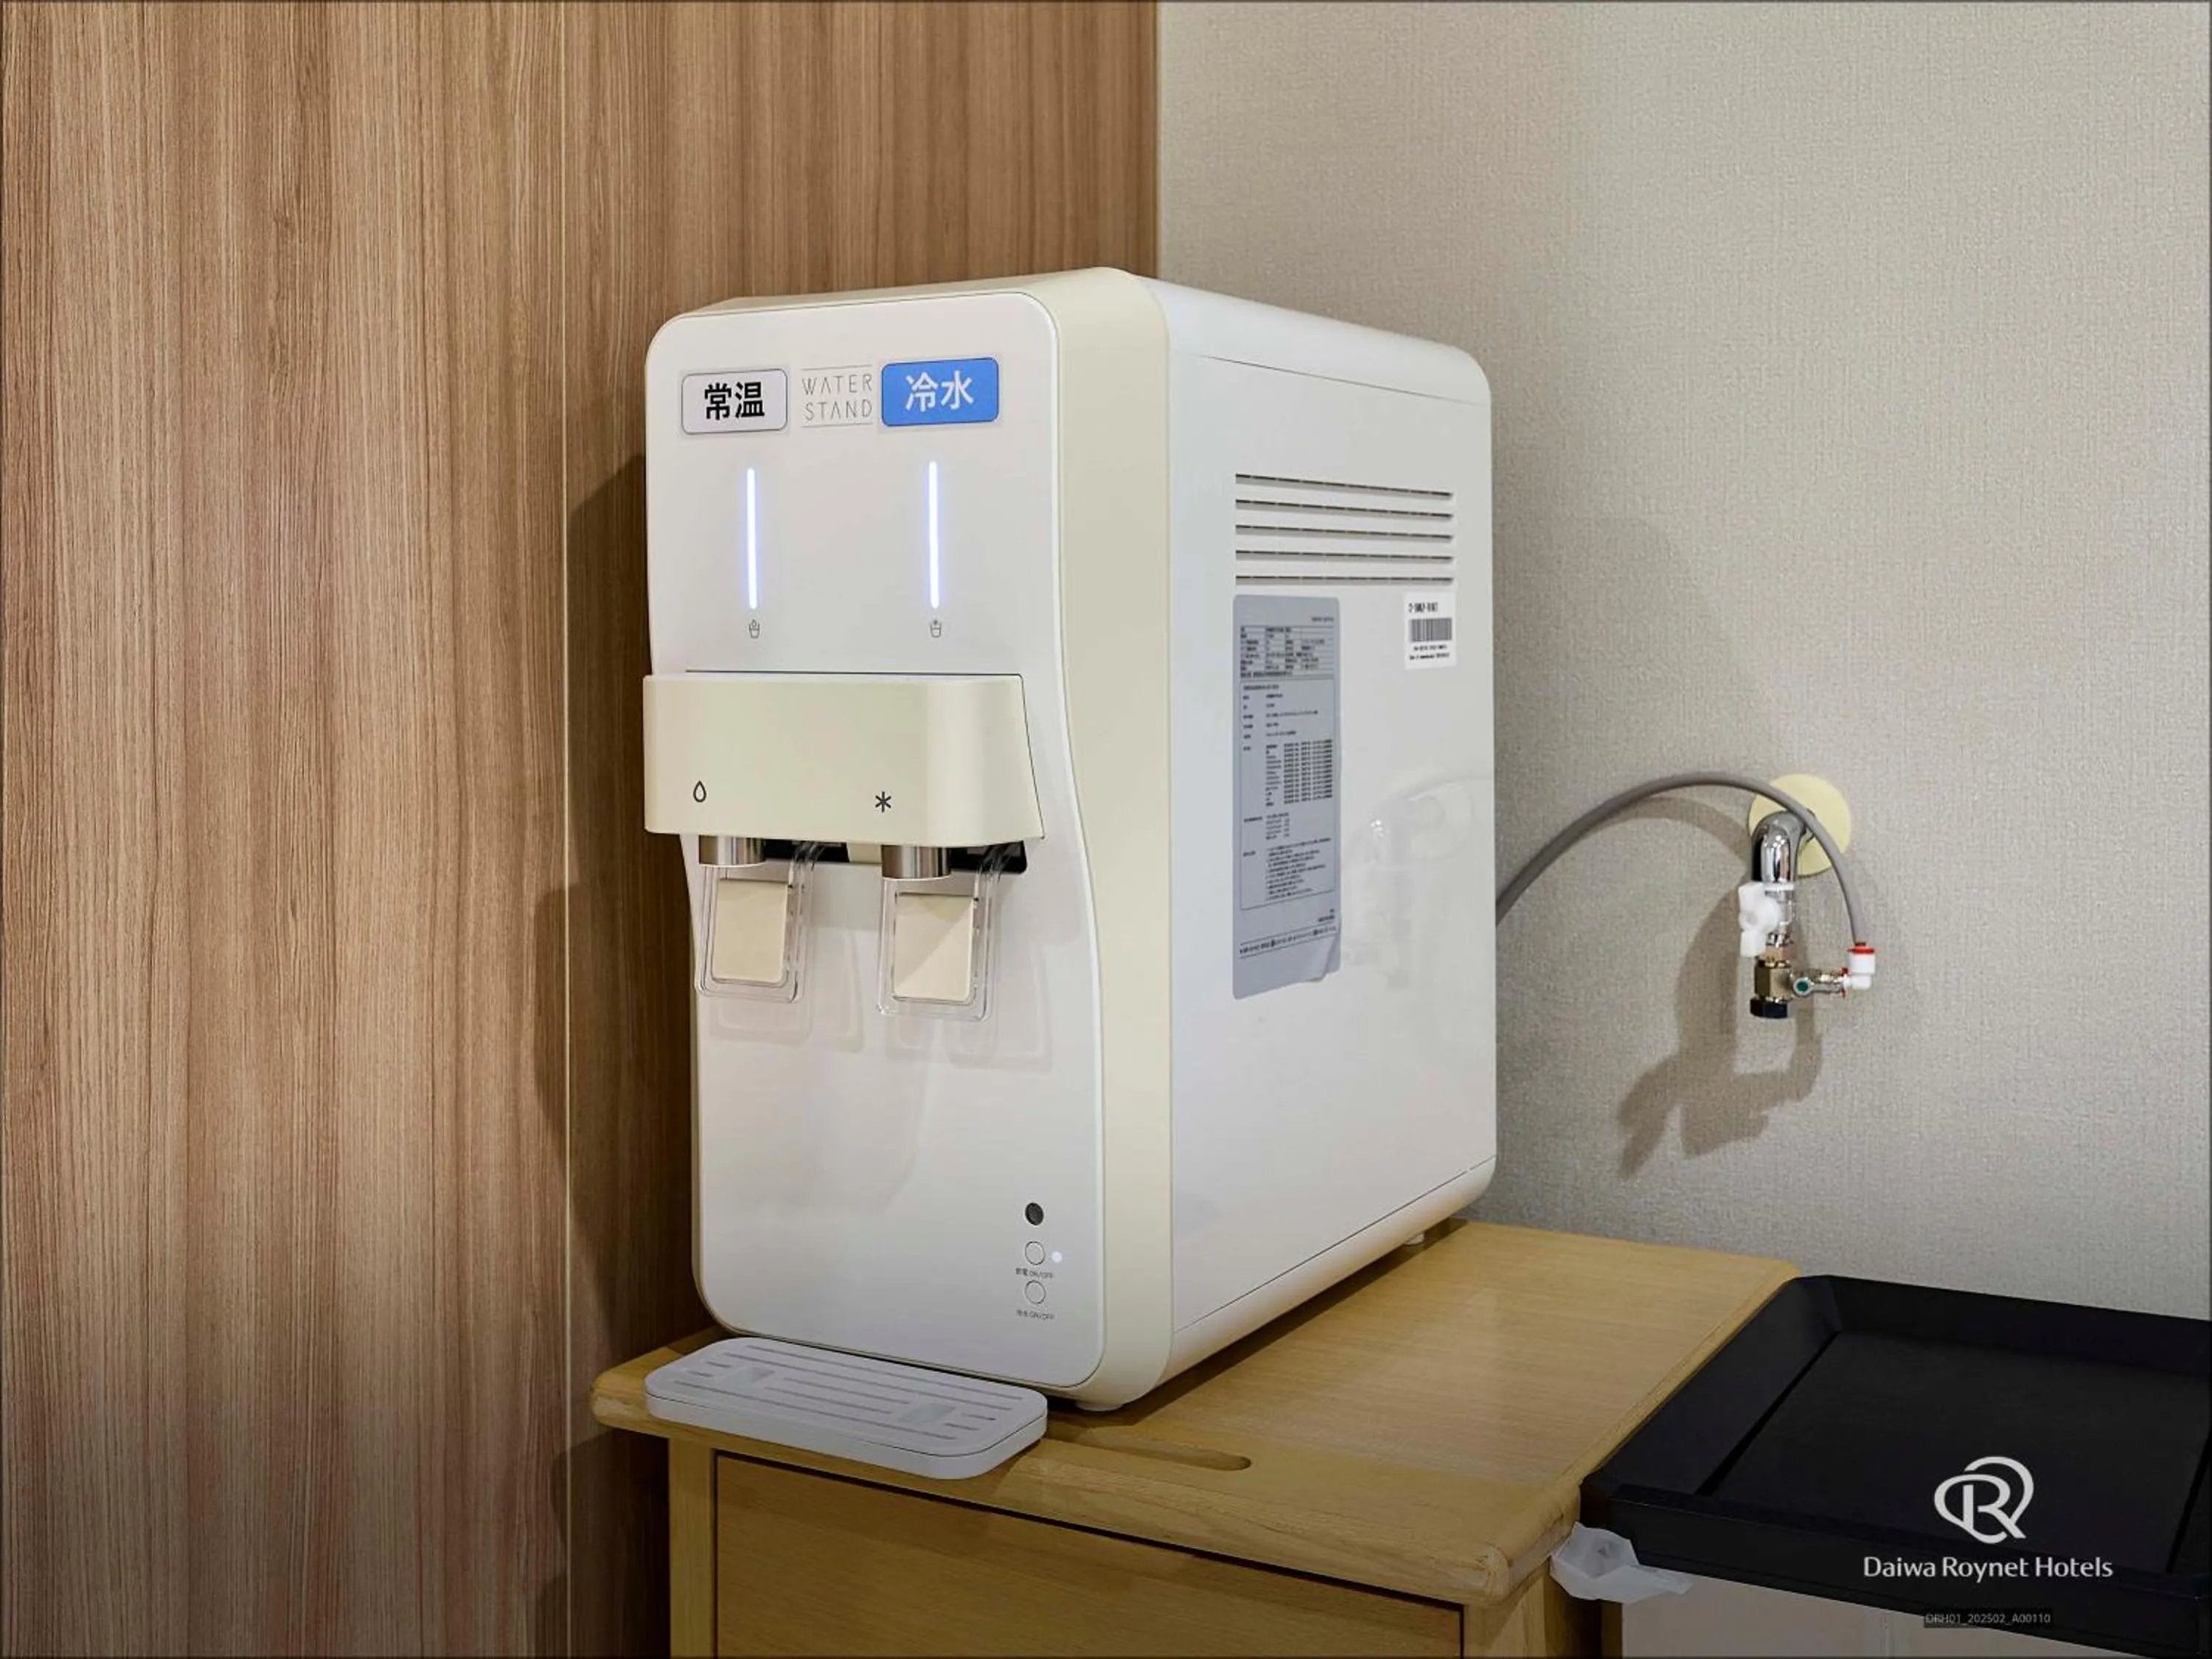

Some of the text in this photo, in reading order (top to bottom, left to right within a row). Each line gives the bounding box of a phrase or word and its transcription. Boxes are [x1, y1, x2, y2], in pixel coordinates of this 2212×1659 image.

[703, 380, 765, 421] 常温
[801, 373, 873, 396] WATER
[905, 370, 974, 412] 冷水
[804, 399, 873, 421] STAND
